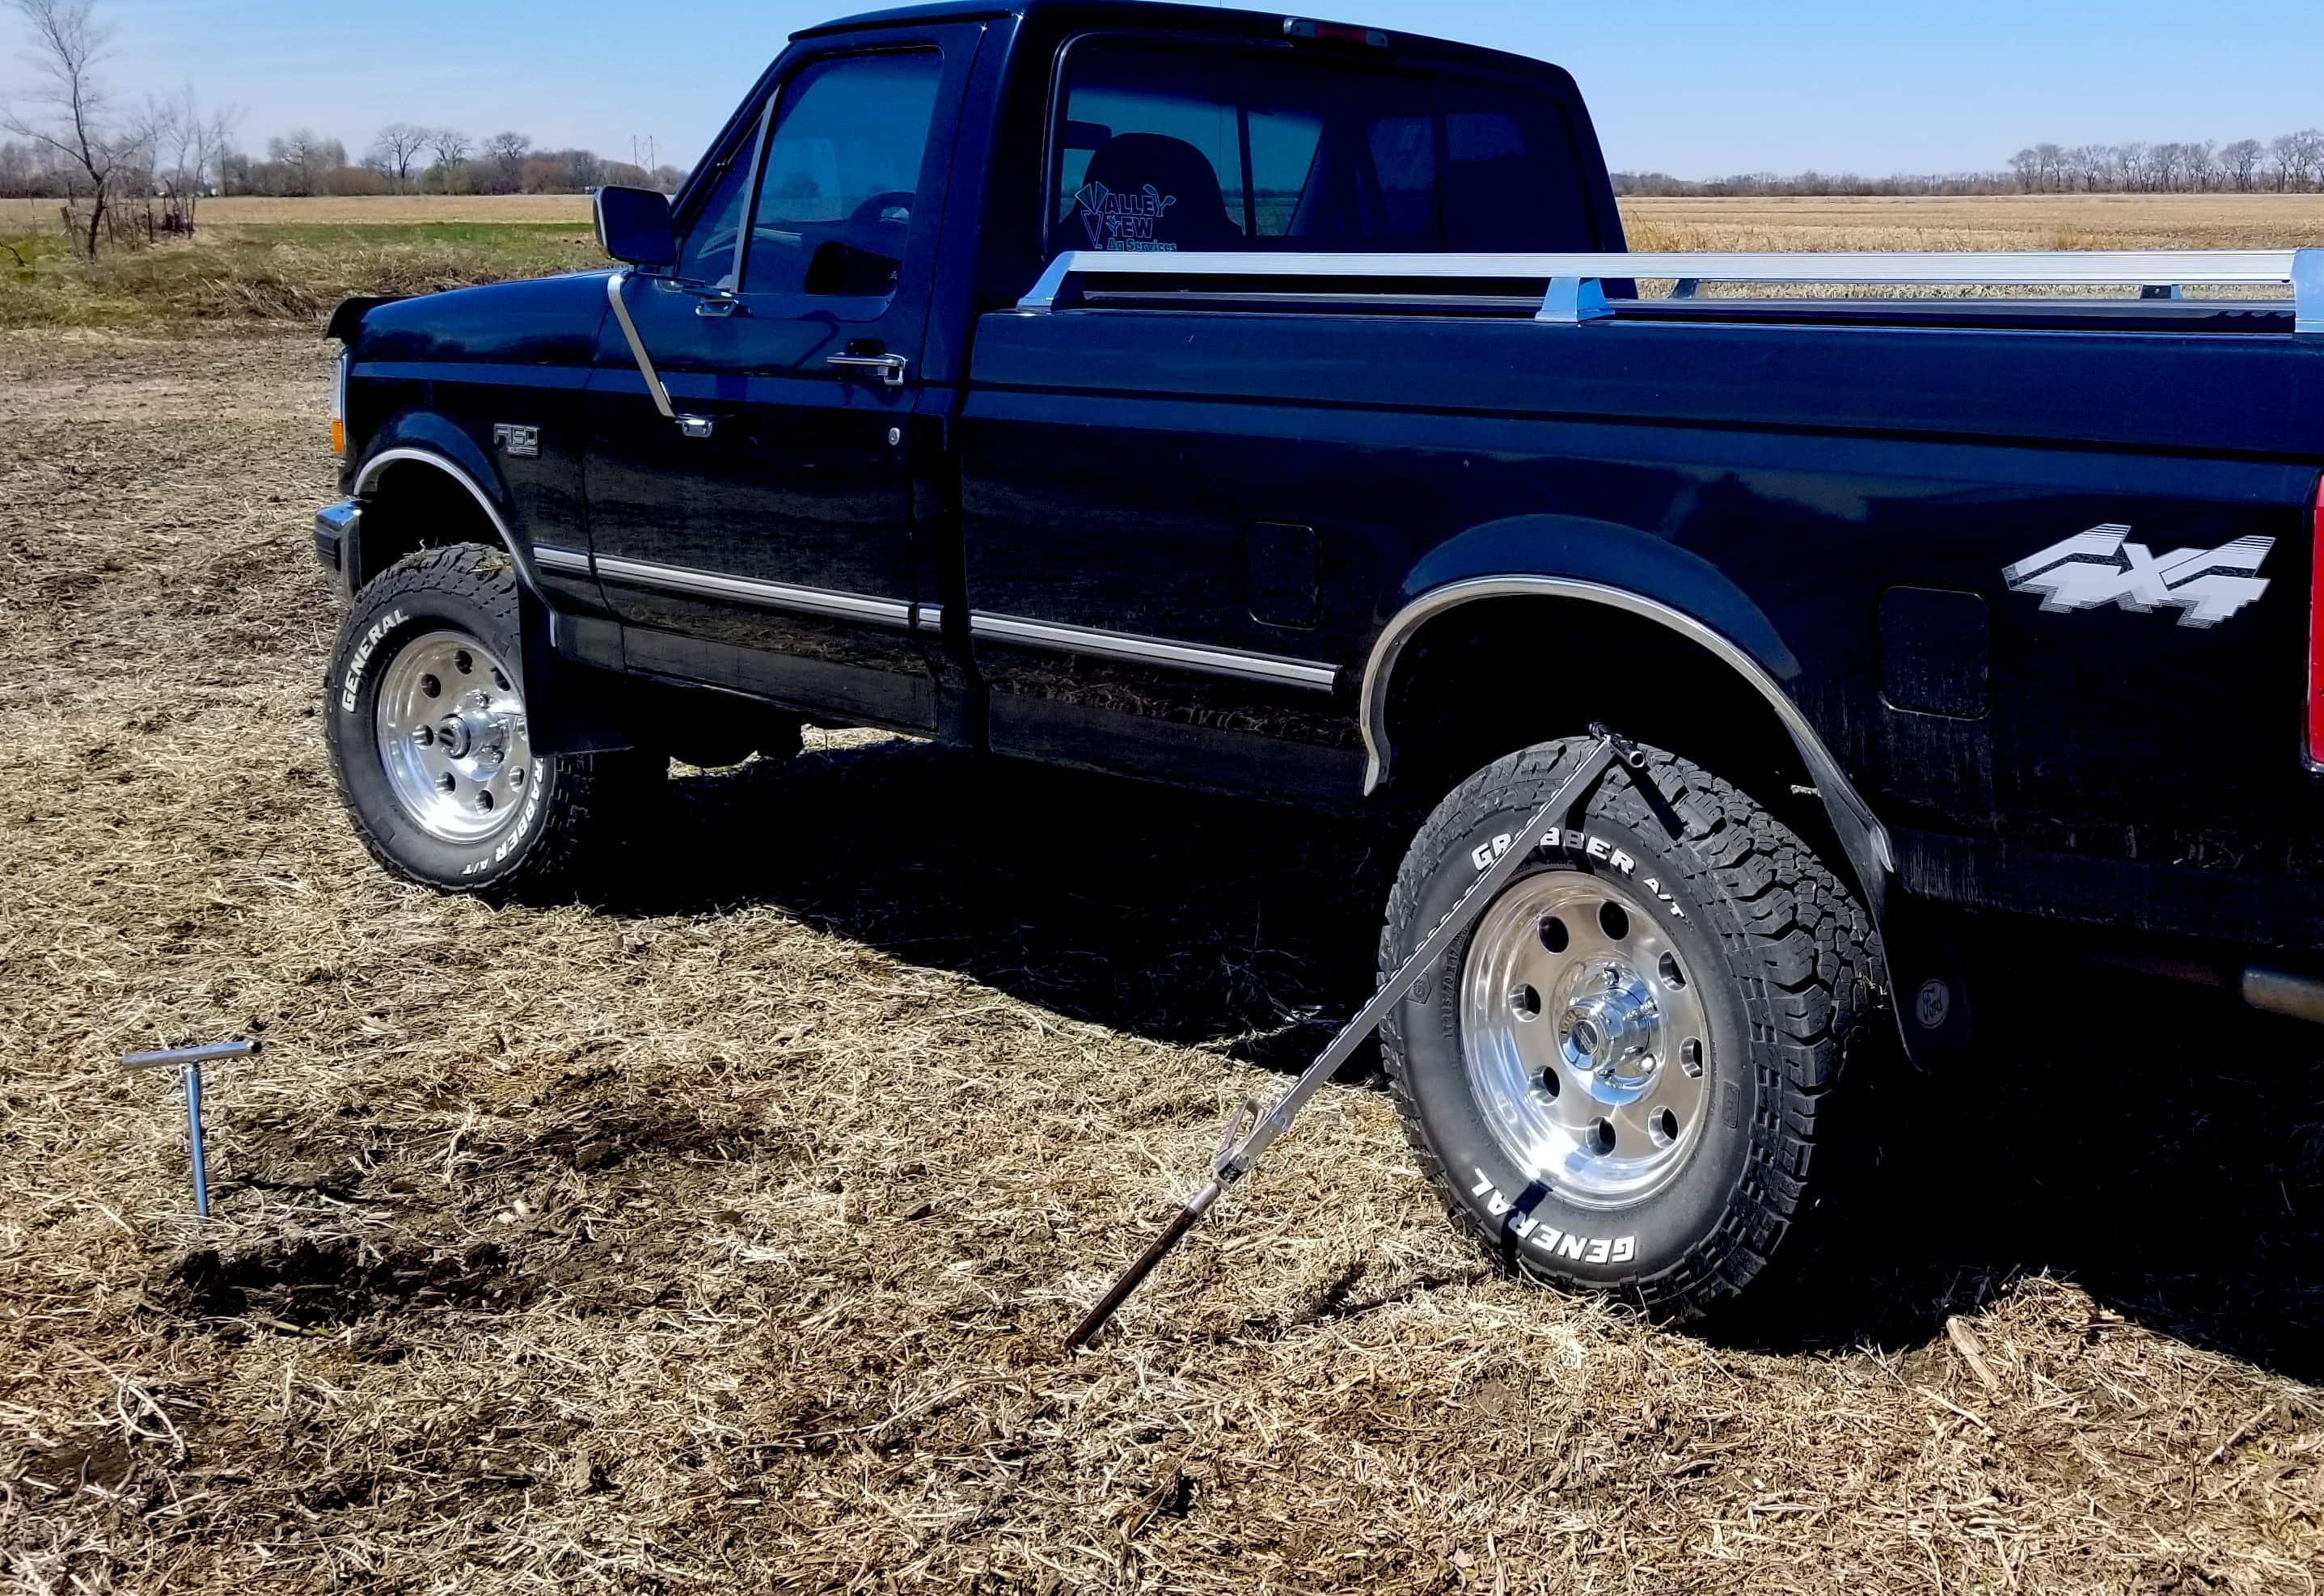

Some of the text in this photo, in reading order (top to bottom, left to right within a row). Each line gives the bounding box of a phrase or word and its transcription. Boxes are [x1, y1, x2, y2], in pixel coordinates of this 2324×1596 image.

[1126, 239, 1177, 252] Services
[342, 609, 409, 712] GENERAL
[461, 758, 544, 876] RABBER A/T
[1471, 826, 1685, 919] GRBBER A/T
[1471, 1167, 1635, 1265] GENERAL
